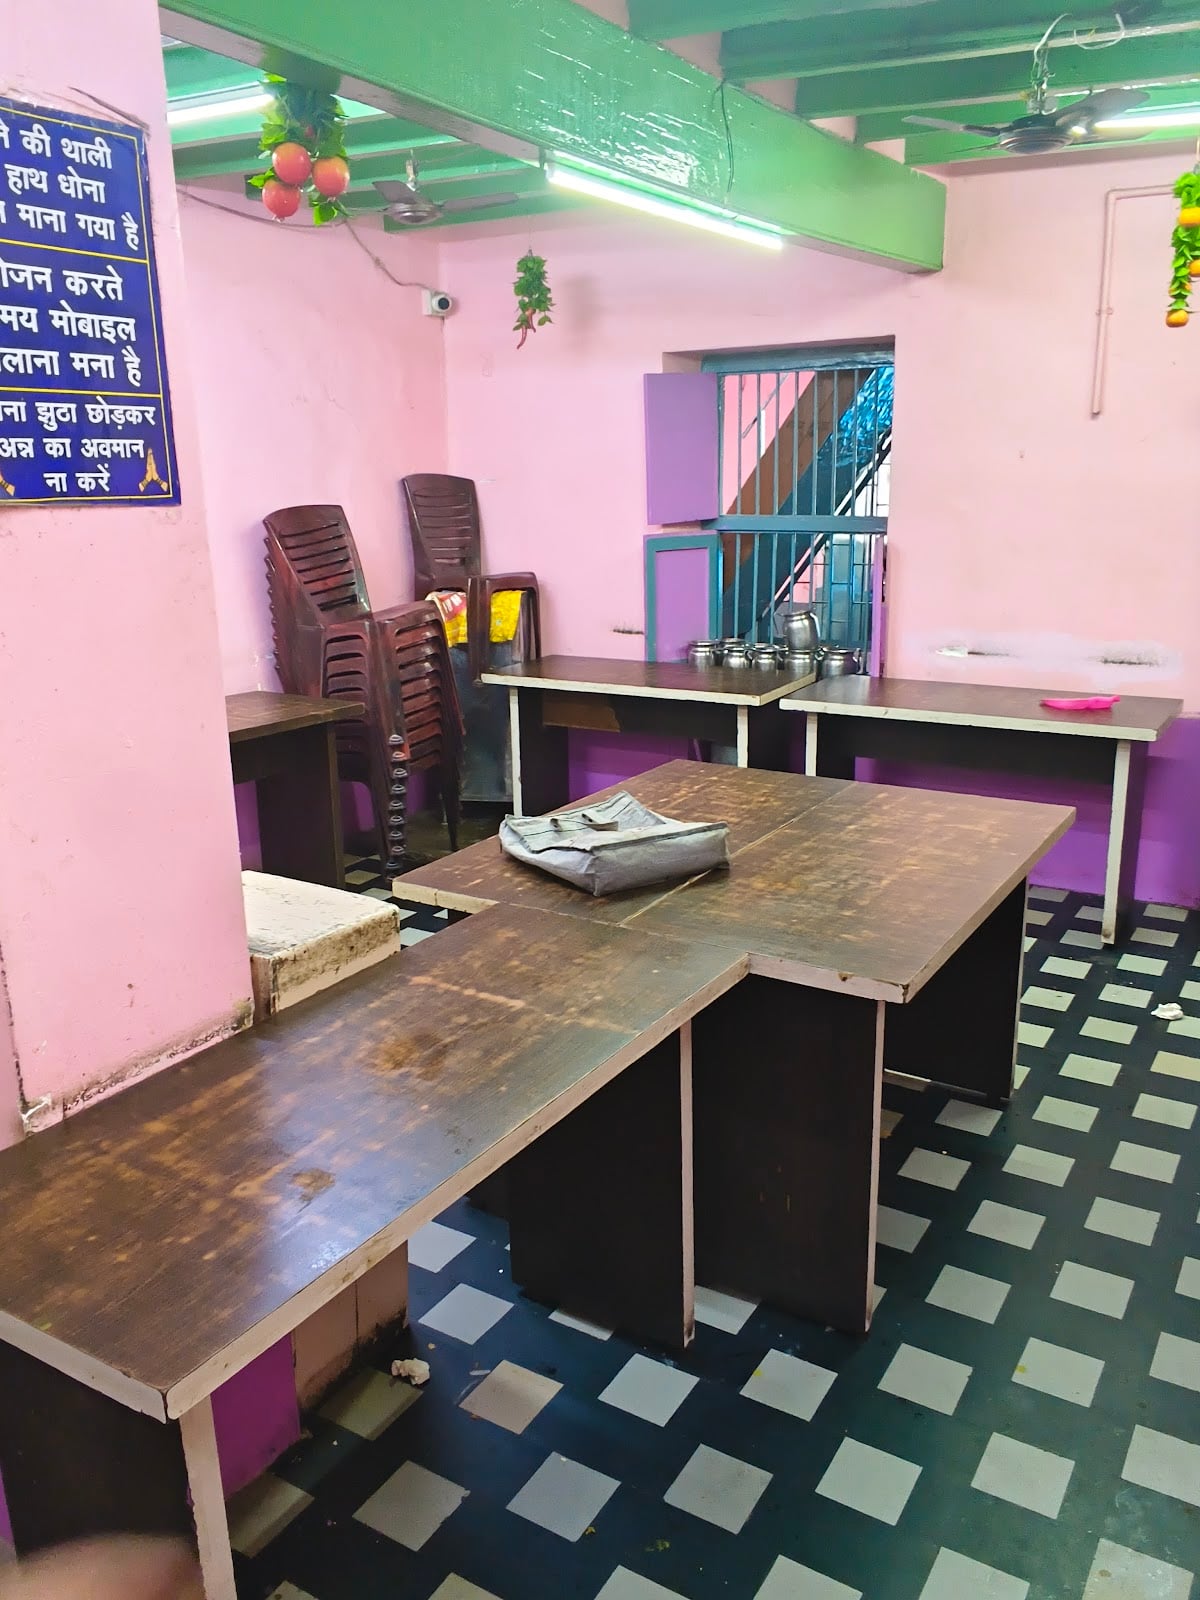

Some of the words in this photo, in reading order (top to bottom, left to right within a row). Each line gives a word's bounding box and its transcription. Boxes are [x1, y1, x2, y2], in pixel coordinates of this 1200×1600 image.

[19, 123, 51, 157] की
[61, 136, 112, 169] थाली
[4, 164, 48, 194] हाथ
[57, 166, 105, 203] धोना
[16, 203, 66, 233] माना
[75, 213, 115, 240] गया
[121, 211, 139, 250] है
[0, 257, 52, 293] ोजन
[62, 265, 123, 300] करते
[0, 304, 38, 333] मय
[48, 300, 136, 344] मोबाइल
[0, 346, 60, 376] लाना
[69, 352, 115, 379] मना
[121, 345, 141, 387] है
[35, 402, 77, 431] झुठा
[85, 395, 156, 430] छोड़कर
[0, 437, 34, 458] अन्न
[43, 437, 71, 458] का
[80, 438, 145, 459] अवमान
[43, 472, 67, 493] ना
[75, 463, 110, 492] करें
